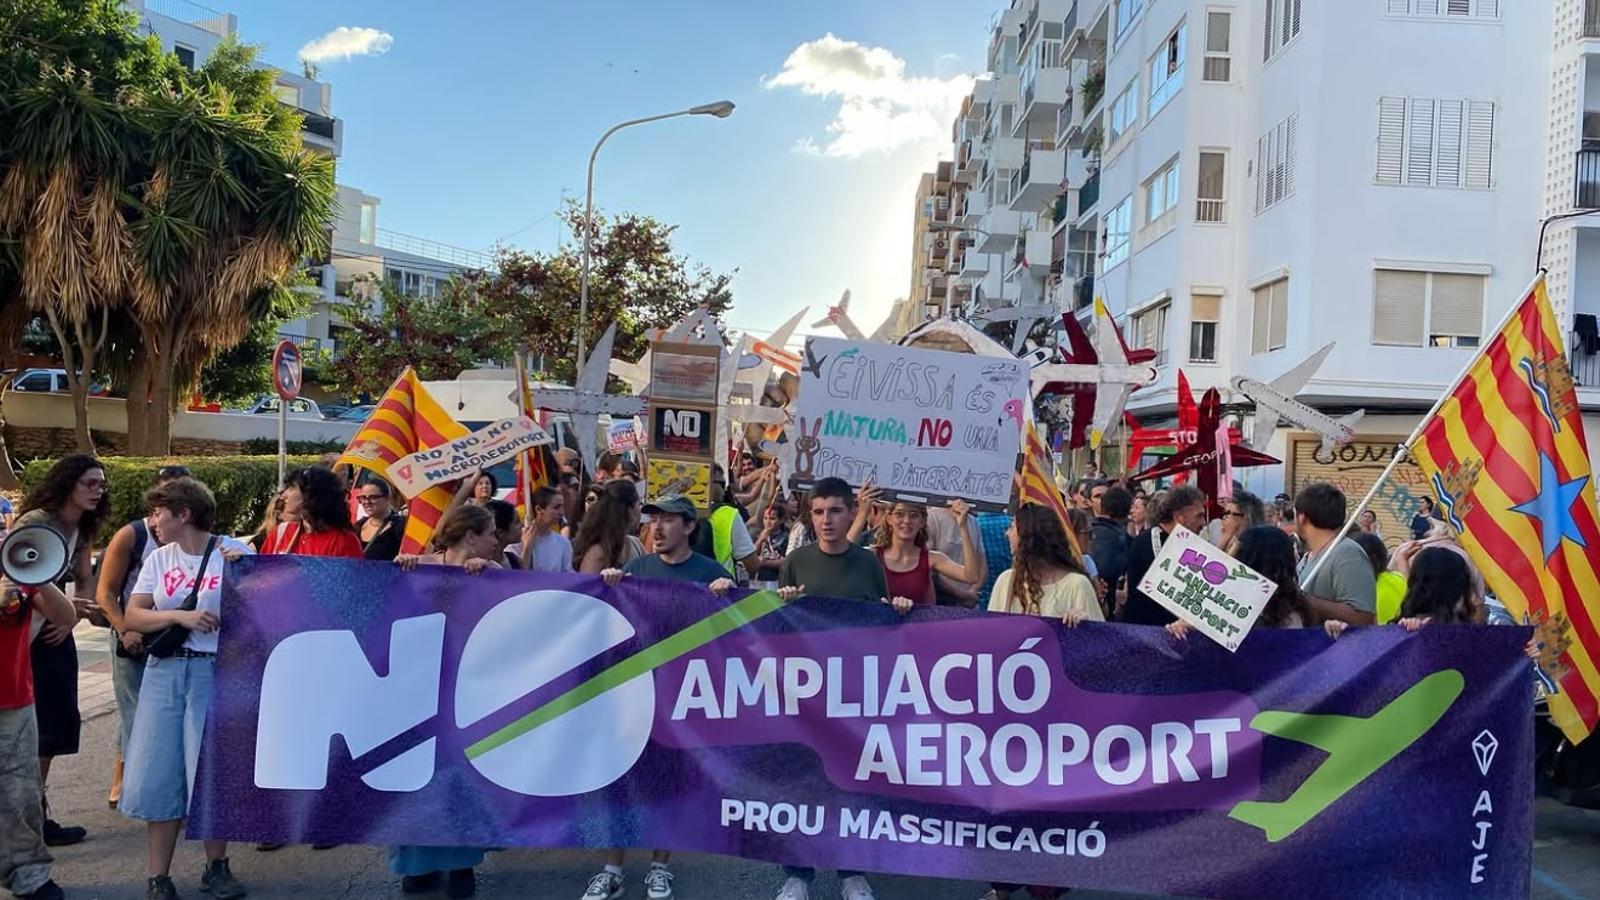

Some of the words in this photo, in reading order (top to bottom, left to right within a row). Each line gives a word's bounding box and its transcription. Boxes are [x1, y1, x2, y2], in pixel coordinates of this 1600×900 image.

[487, 421, 513, 438] NO
[664, 409, 701, 438] NO
[917, 417, 953, 448] NO
[963, 425, 1000, 452] UNA
[1168, 430, 1198, 444] STO
[424, 431, 545, 481] MACROAEROPORT
[451, 450, 478, 464] AL
[1159, 558, 1172, 572] A
[1178, 548, 1229, 586] NO
[254, 589, 656, 797] NO
[671, 637, 1052, 721] AMPLIACIÓ
[854, 717, 1242, 788] AEROPORT
[720, 798, 825, 836] PROU
[839, 806, 1107, 858] MASSIFICACIÓ
[1470, 789, 1493, 884] AJE
